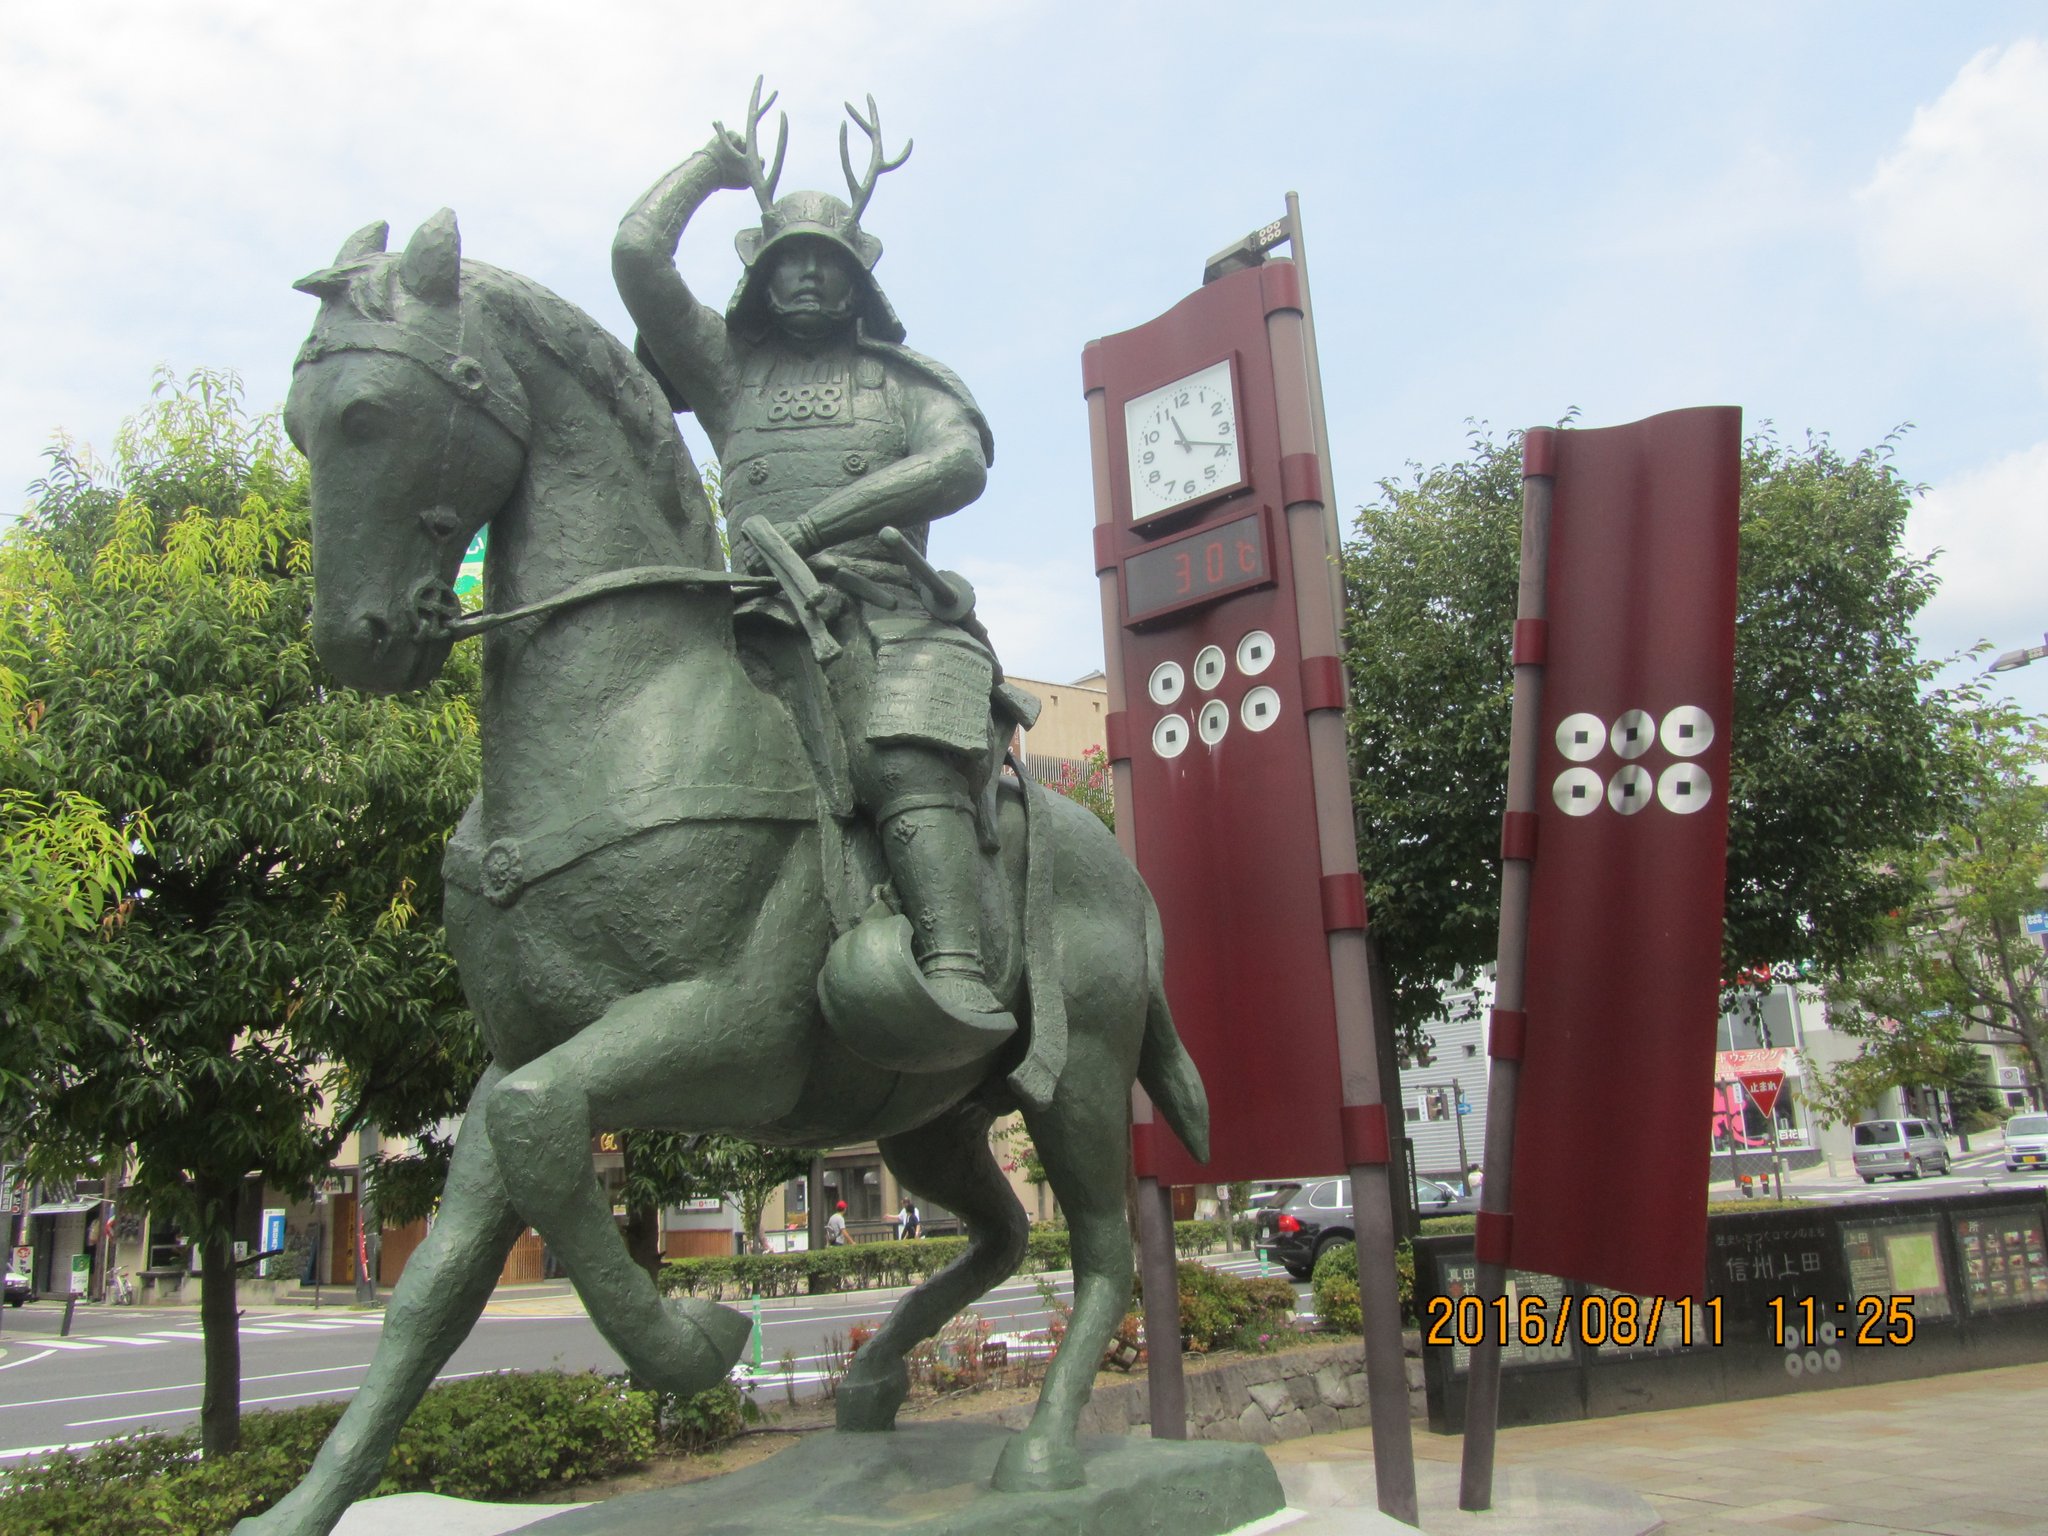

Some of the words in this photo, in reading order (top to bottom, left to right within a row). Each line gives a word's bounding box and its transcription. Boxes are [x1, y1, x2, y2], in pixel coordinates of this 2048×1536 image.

[1174, 392, 1190, 409] 12
[1199, 391, 1204, 403] 1
[1156, 407, 1170, 424] 11
[1211, 401, 1223, 417] 2
[1218, 421, 1230, 435] 3
[1144, 430, 1160, 446] 10
[1143, 450, 1155, 464] 9
[1214, 445, 1227, 458] 4
[1149, 470, 1161, 484] 8
[1204, 464, 1216, 479] 5
[1164, 480, 1176, 495] 7
[1183, 480, 1196, 494] 6
[1750, 1081, 1777, 1093] 止まれ
[1726, 1252, 1821, 1281] 信州上田
